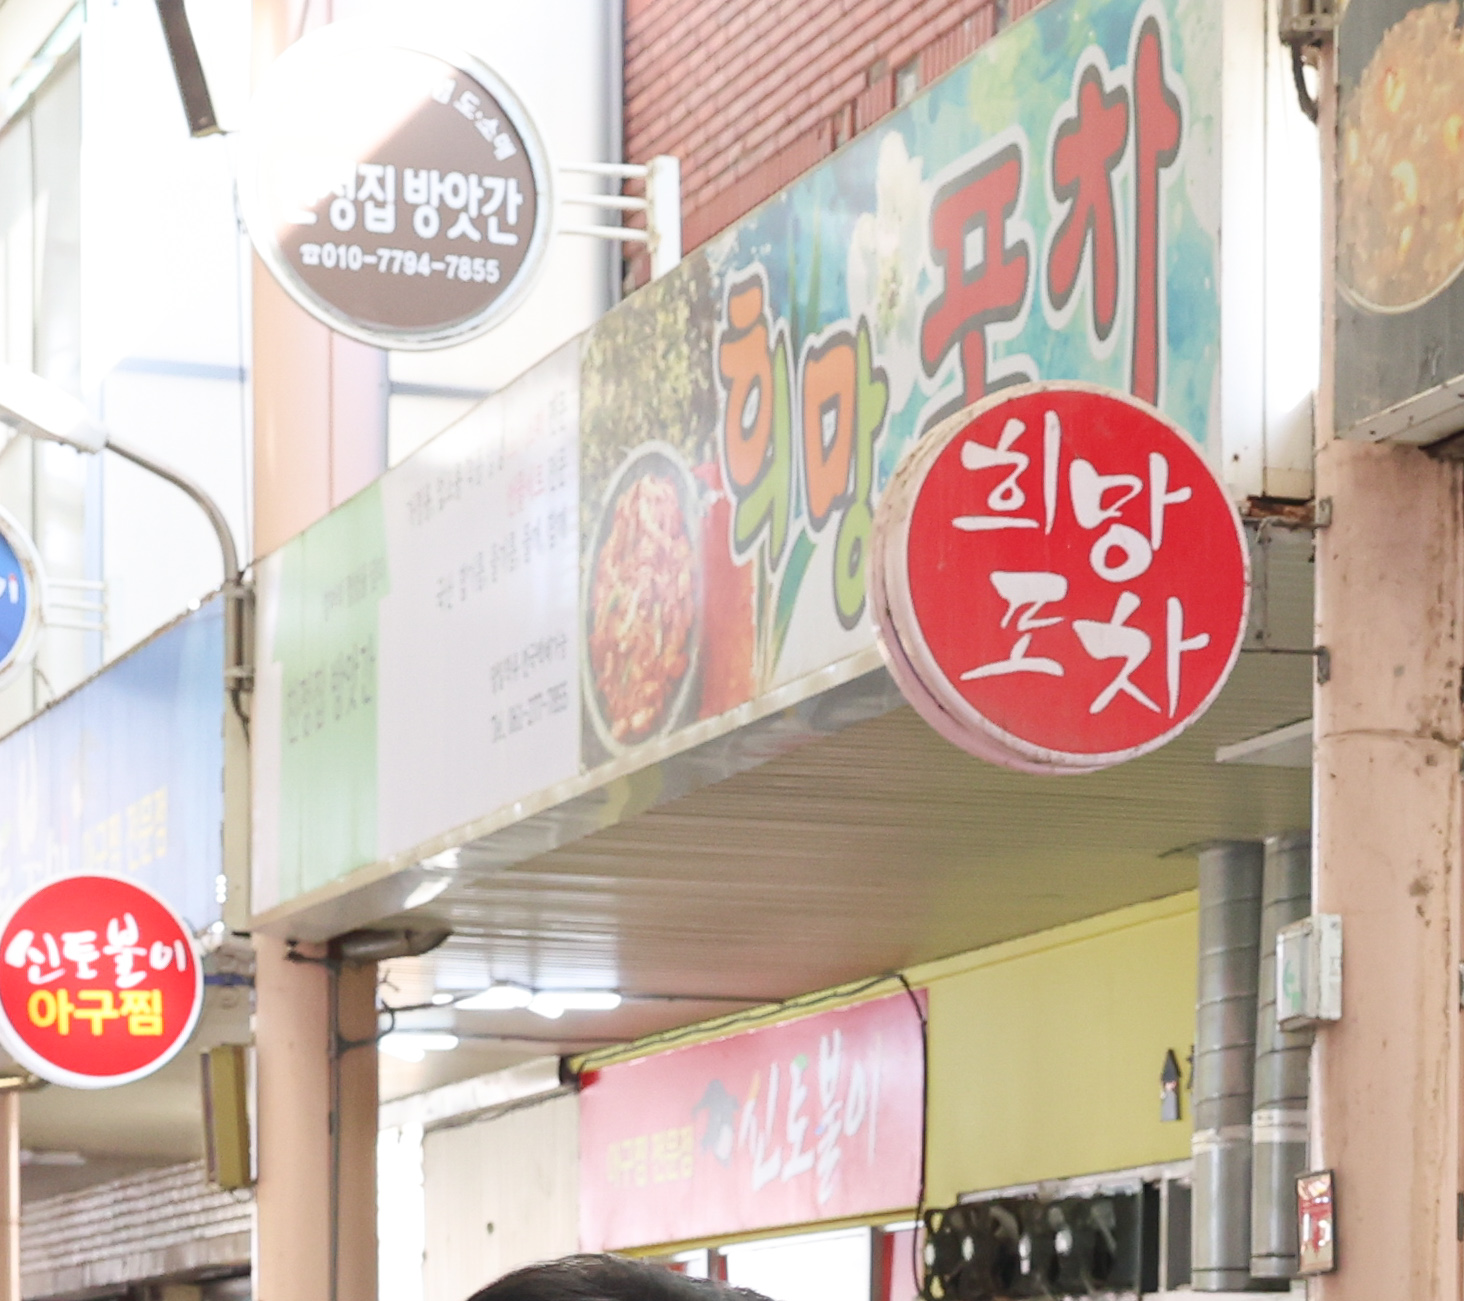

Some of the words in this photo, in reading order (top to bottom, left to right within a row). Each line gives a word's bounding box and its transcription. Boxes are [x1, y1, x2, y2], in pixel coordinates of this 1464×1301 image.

[403, 167, 524, 246] 방앗간
[951, 409, 1192, 583] 희망
[959, 570, 1211, 718] 포차
[5, 912, 187, 989] 신토불이
[27, 987, 164, 1037] 아구찜
[739, 1028, 885, 1205] 신토불이
